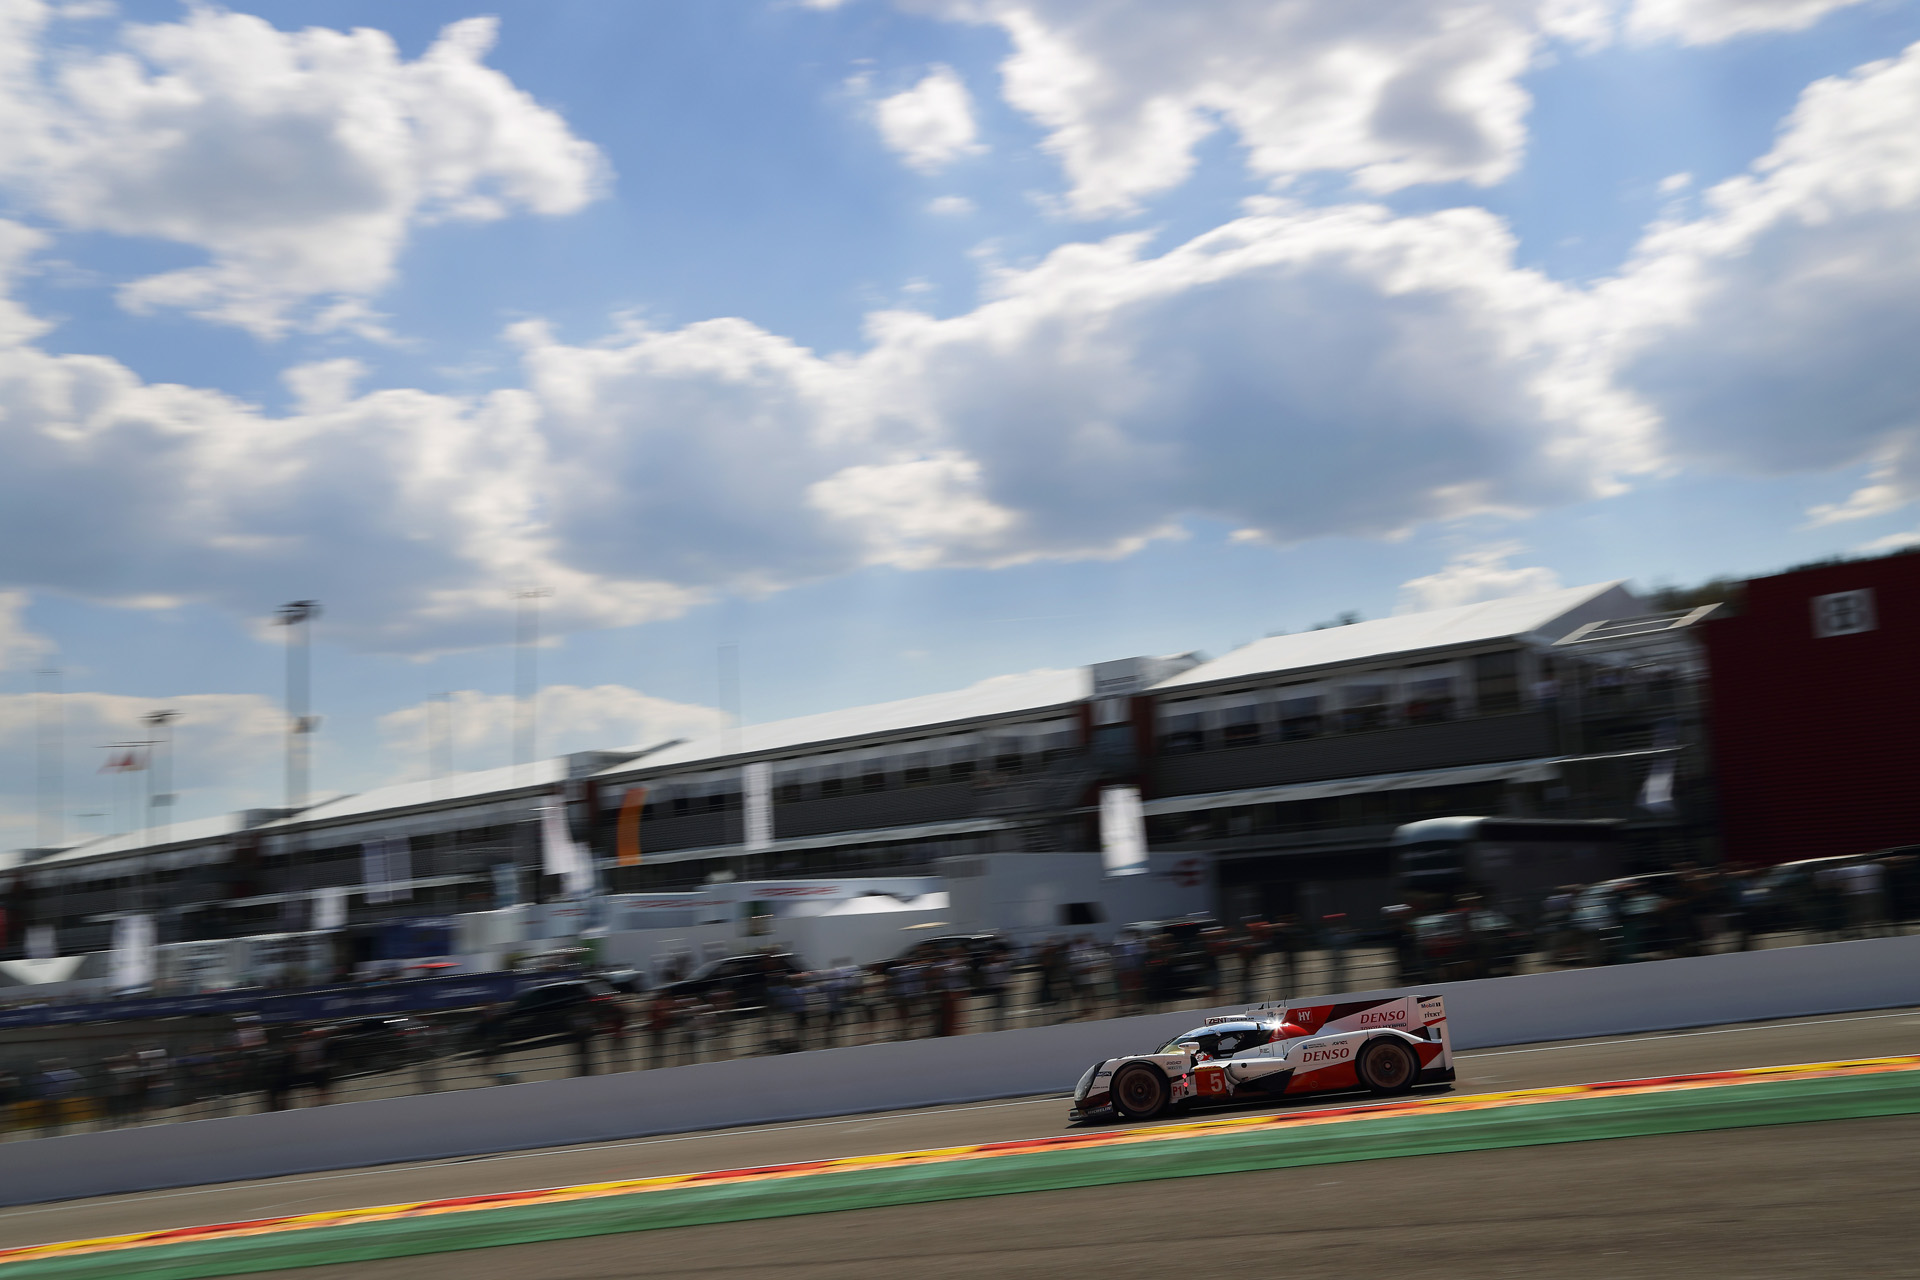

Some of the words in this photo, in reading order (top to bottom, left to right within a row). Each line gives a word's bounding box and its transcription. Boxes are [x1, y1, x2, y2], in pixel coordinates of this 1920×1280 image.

[1208, 1016, 1227, 1025] ZENT
[1298, 1010, 1311, 1022] HY
[1360, 1009, 1406, 1024] DENSO
[1303, 1047, 1350, 1063] DENSO
[1210, 1072, 1223, 1092] 5
[1172, 1085, 1183, 1097] P1
[1087, 1106, 1111, 1115] MICHELIN
